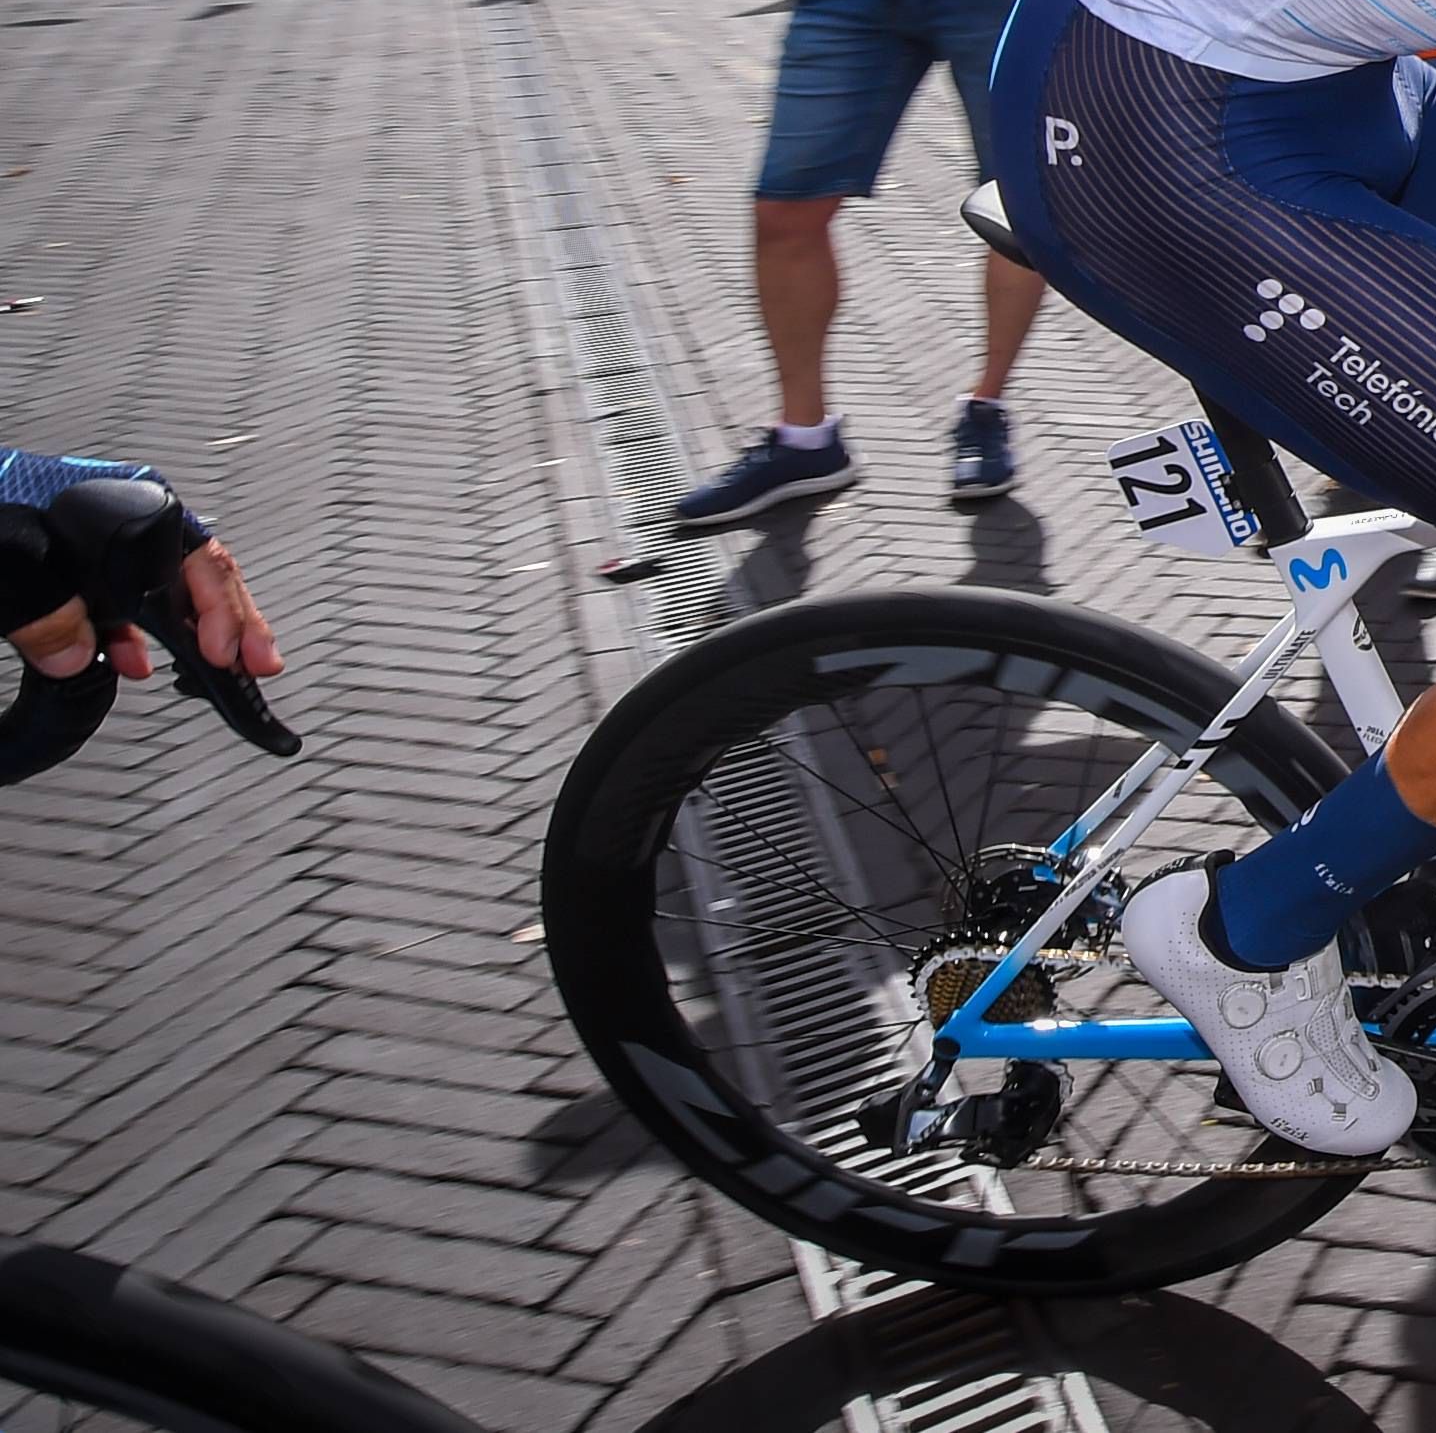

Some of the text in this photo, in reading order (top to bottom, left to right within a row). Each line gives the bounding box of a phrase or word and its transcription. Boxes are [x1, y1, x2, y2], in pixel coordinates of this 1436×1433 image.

[1304, 361, 1374, 428] Tech
[1109, 435, 1208, 532] 121
[1262, 629, 1317, 680] ULTIMATE
